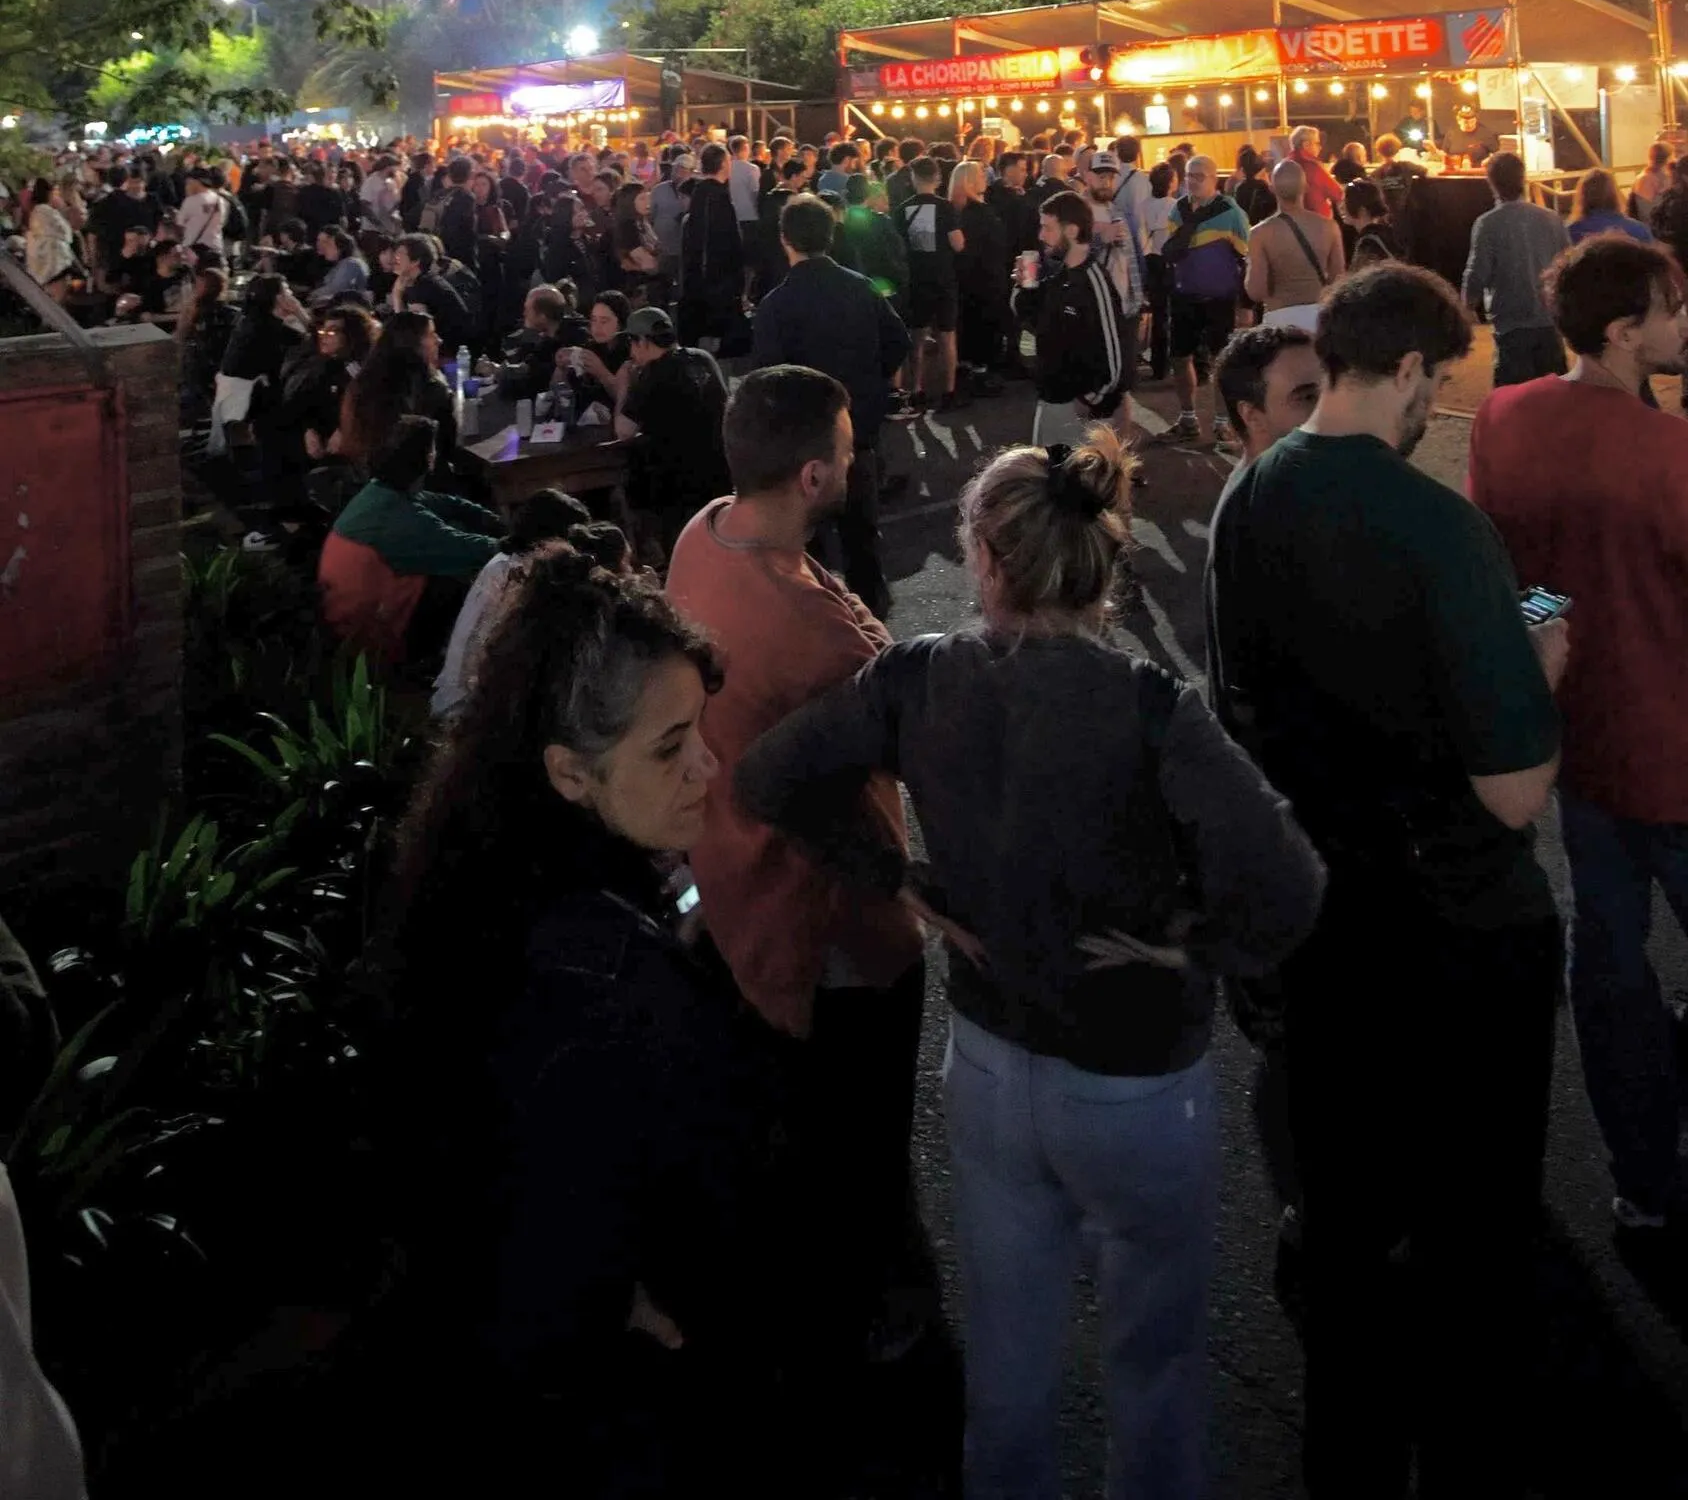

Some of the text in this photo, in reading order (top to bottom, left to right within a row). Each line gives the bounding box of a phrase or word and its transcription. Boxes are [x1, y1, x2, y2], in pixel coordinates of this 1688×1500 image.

[1279, 23, 1429, 59] VEDETTE
[885, 67, 909, 88] LA
[911, 53, 1055, 86] CHORIPANERIA
